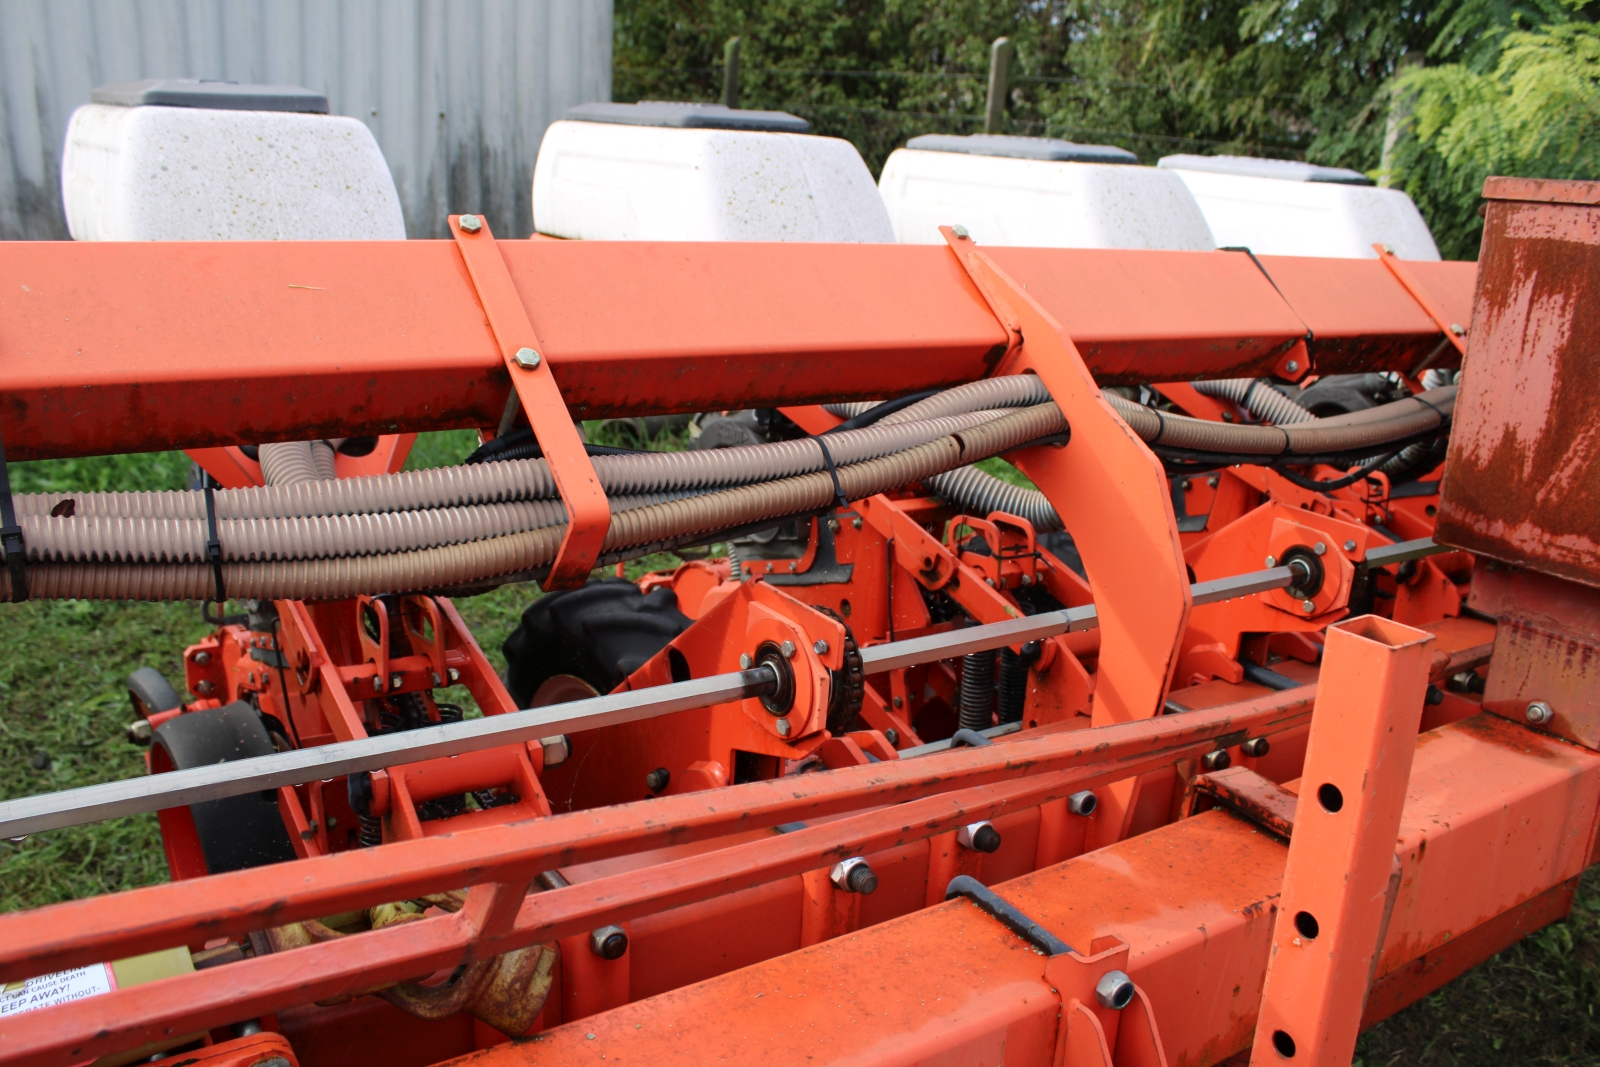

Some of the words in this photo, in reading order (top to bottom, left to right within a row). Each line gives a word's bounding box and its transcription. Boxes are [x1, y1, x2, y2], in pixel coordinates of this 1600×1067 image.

[31, 980, 58, 993] CAUSE
[60, 971, 86, 984] DEATH
[30, 984, 70, 1004] AWAY!
